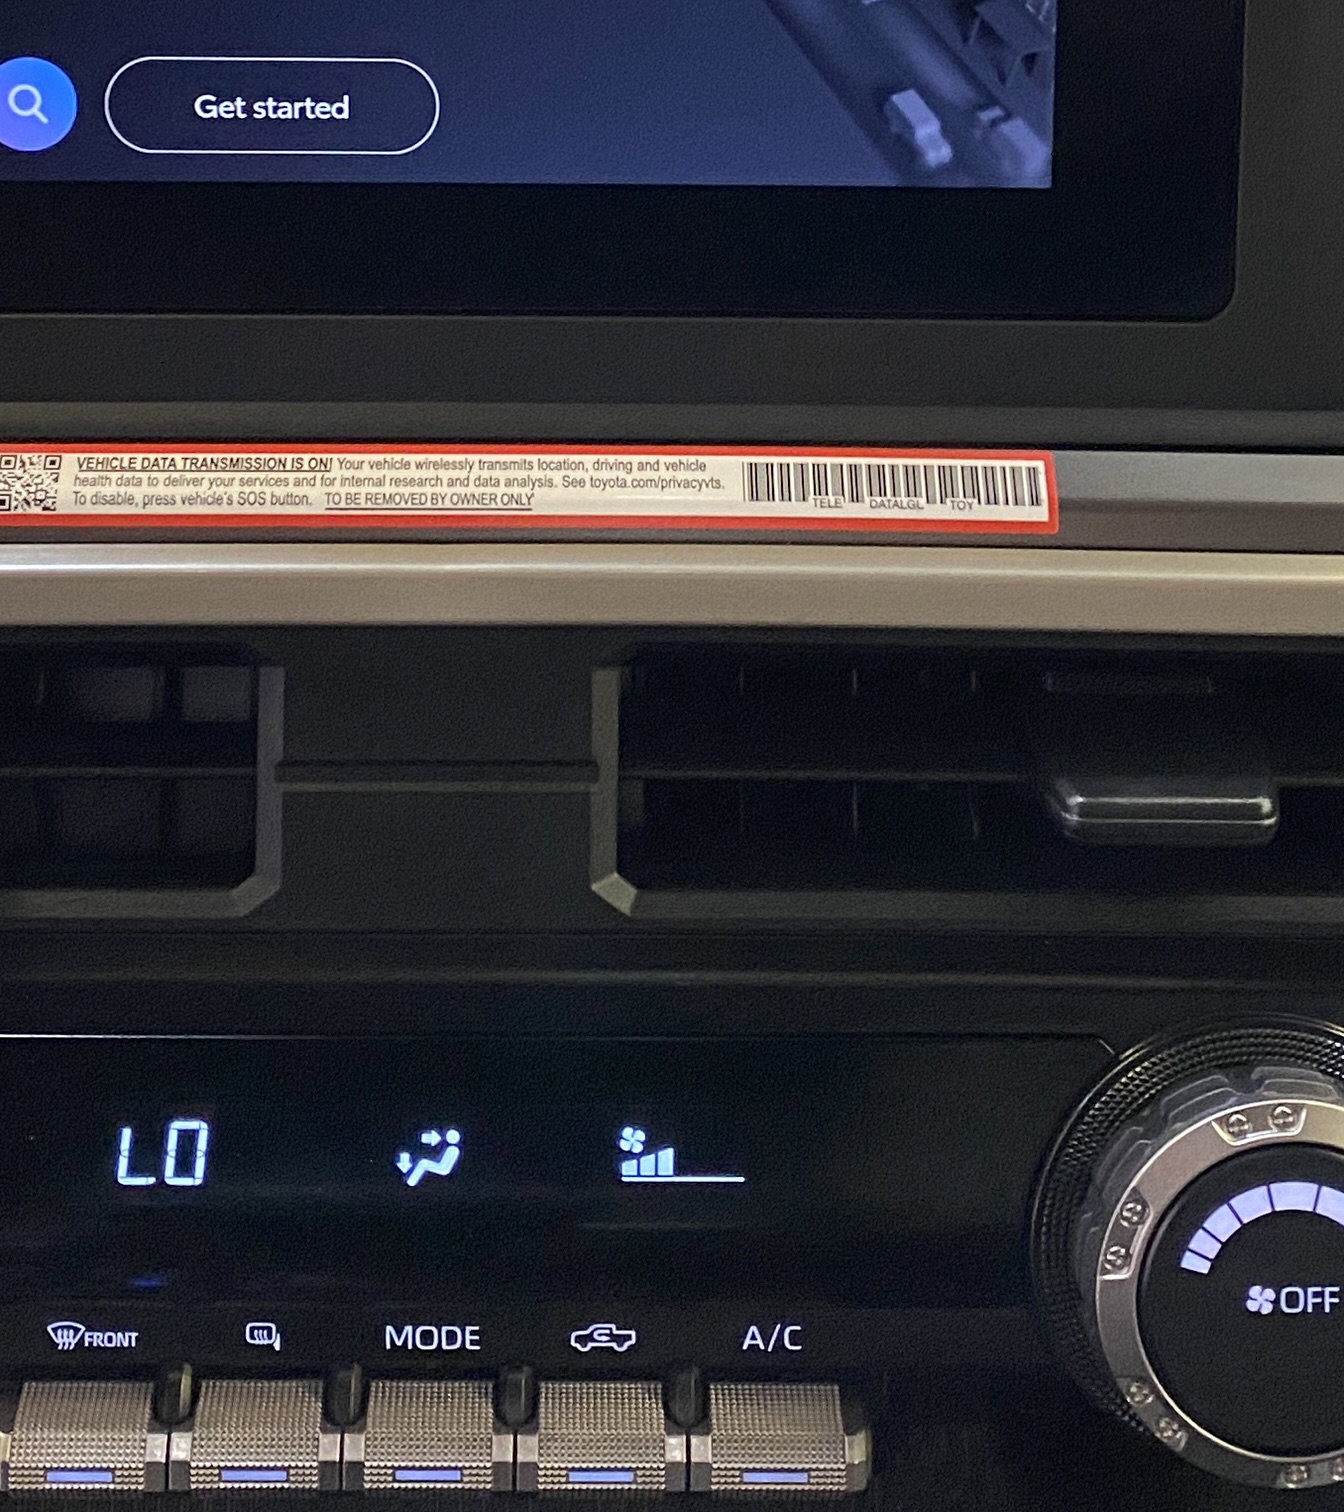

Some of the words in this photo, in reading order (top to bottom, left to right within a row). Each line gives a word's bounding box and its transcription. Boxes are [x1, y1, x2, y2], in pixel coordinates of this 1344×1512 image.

[194, 94, 247, 120] Get
[252, 93, 350, 121] started
[77, 457, 140, 470] VEHICLE
[143, 457, 177, 470] DATA
[181, 457, 288, 470] TRANSMISSION
[291, 457, 304, 470] IS
[337, 458, 365, 471] Your
[368, 458, 411, 471] vehicle
[414, 458, 474, 473] wirelessly
[478, 459, 533, 471] transmits
[537, 459, 588, 473] location,
[592, 459, 633, 473] driving
[637, 459, 660, 472] and
[664, 460, 707, 472] vehicle
[74, 474, 111, 487] health
[116, 474, 143, 487] data
[147, 475, 159, 487] to
[163, 474, 204, 487] deliver
[208, 477, 235, 490] your
[239, 475, 289, 487] services
[293, 475, 316, 487] and
[320, 474, 337, 487] for
[340, 475, 386, 487] internal
[389, 475, 443, 488] research
[447, 475, 469, 488] and
[473, 476, 500, 488] data
[504, 476, 558, 491] analysis.
[562, 476, 586, 488] See
[590, 476, 725, 491] toyota.com/privacyvts.
[73, 491, 87, 505] To
[90, 491, 138, 507] disable,
[143, 494, 176, 509] press
[181, 491, 233, 505] vehicle's
[237, 491, 266, 506] SOS
[270, 492, 312, 506] button.
[325, 493, 341, 506] TO
[345, 493, 361, 506] BE
[365, 493, 427, 506] REMOVED
[430, 493, 447, 506] BY
[450, 493, 497, 506] OWNER
[501, 493, 534, 506] ONLY
[812, 498, 843, 509] TELE
[950, 500, 974, 511] TOY
[117, 1118, 210, 1189] LO
[1279, 1286, 1340, 1314] OFF
[84, 1331, 139, 1350] FRONT
[385, 1325, 482, 1351] MODE
[743, 1325, 803, 1353] A/C
